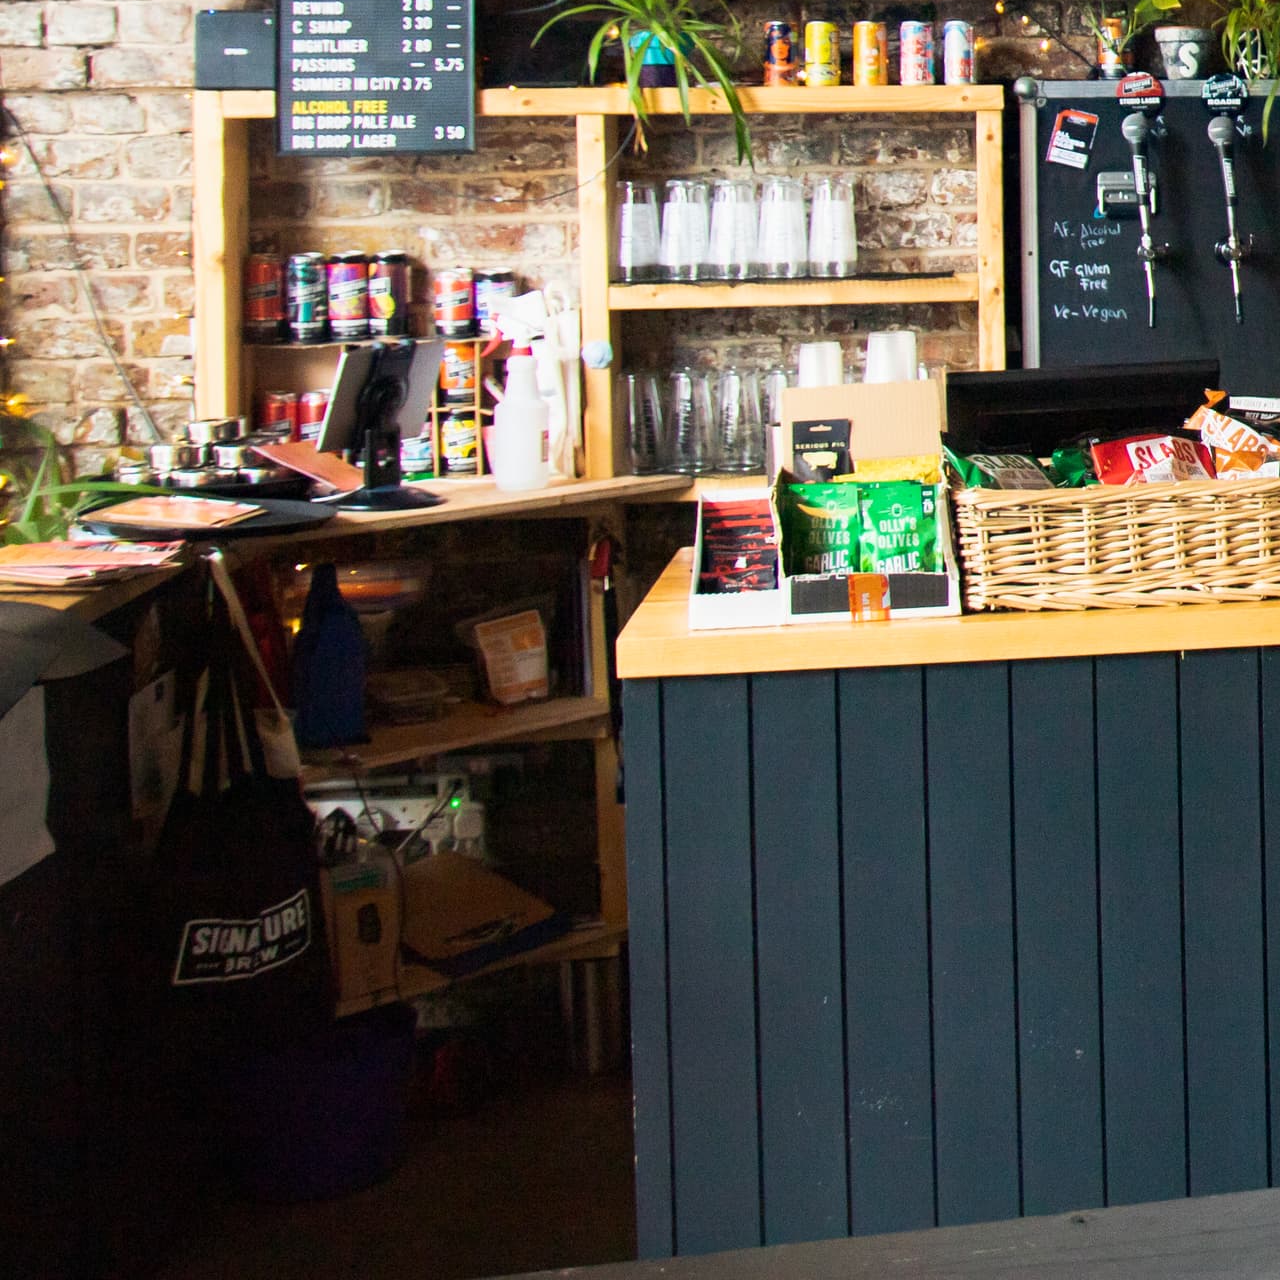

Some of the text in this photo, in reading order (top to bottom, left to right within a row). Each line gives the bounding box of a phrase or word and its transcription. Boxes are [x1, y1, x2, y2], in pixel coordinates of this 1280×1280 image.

[292, 1, 343, 15] REWIND
[292, 21, 352, 34] C SHARP
[292, 40, 368, 53] NIGHTLINER
[292, 59, 355, 72] PASSIONS
[292, 78, 351, 92] SUMMER
[370, 78, 399, 91] CITY
[292, 100, 388, 115] ALCOHOL FREE
[354, 115, 388, 129] PALE
[391, 115, 416, 128] ALE
[354, 135, 397, 149] LAGER
[1083, 304, 1127, 322] Vegan
[795, 442, 829, 450] SERIOUS
[1134, 438, 1196, 470] SLABS
[877, 533, 919, 549] OLIVES
